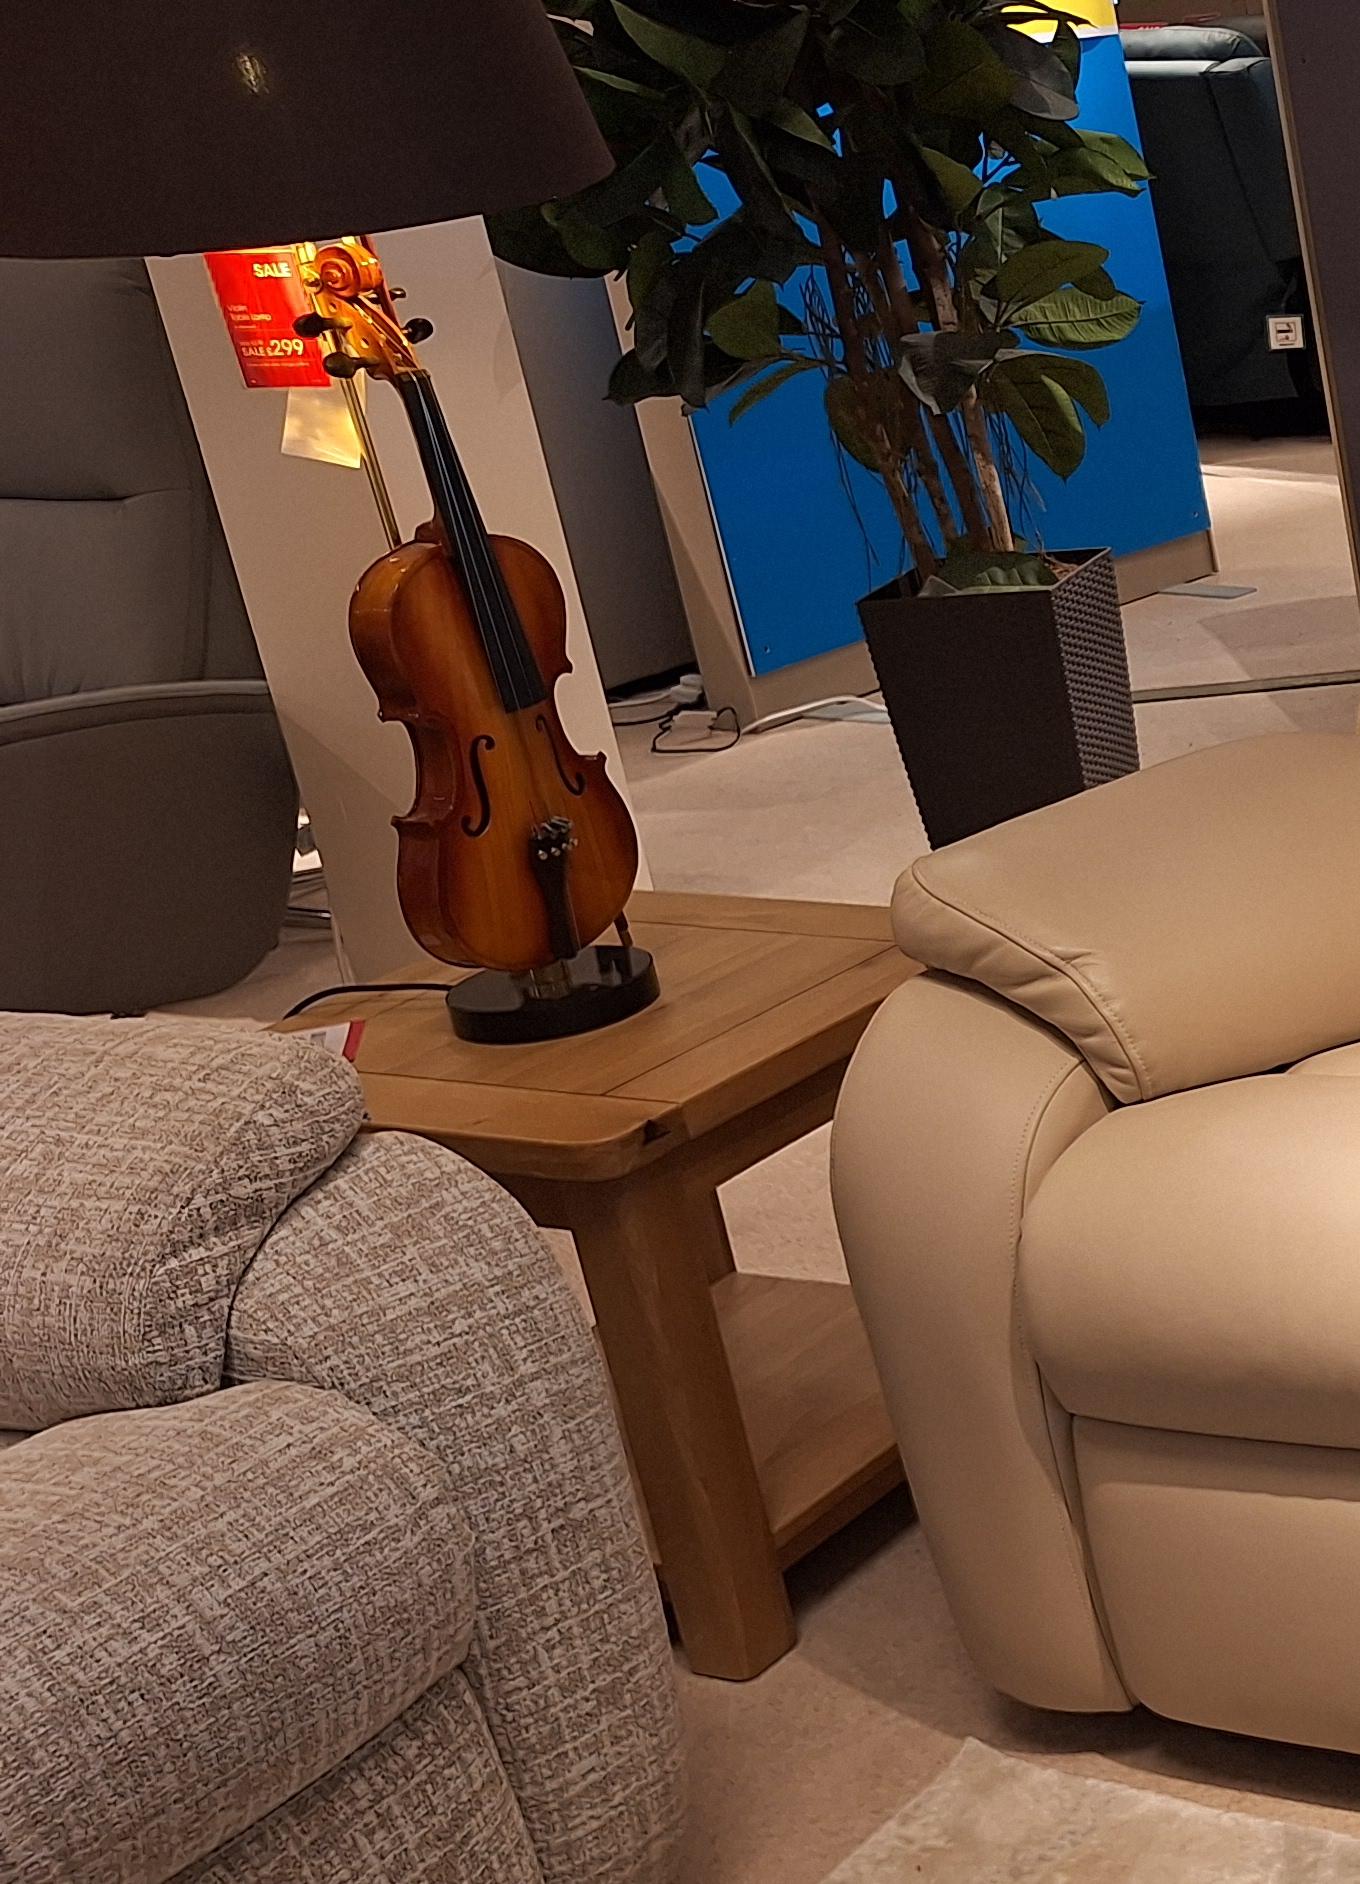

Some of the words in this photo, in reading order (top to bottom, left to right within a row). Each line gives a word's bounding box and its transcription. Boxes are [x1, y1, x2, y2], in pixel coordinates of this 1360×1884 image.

[253, 262, 292, 278] SALE
[242, 346, 265, 356] SALE
[266, 339, 304, 356] £299
